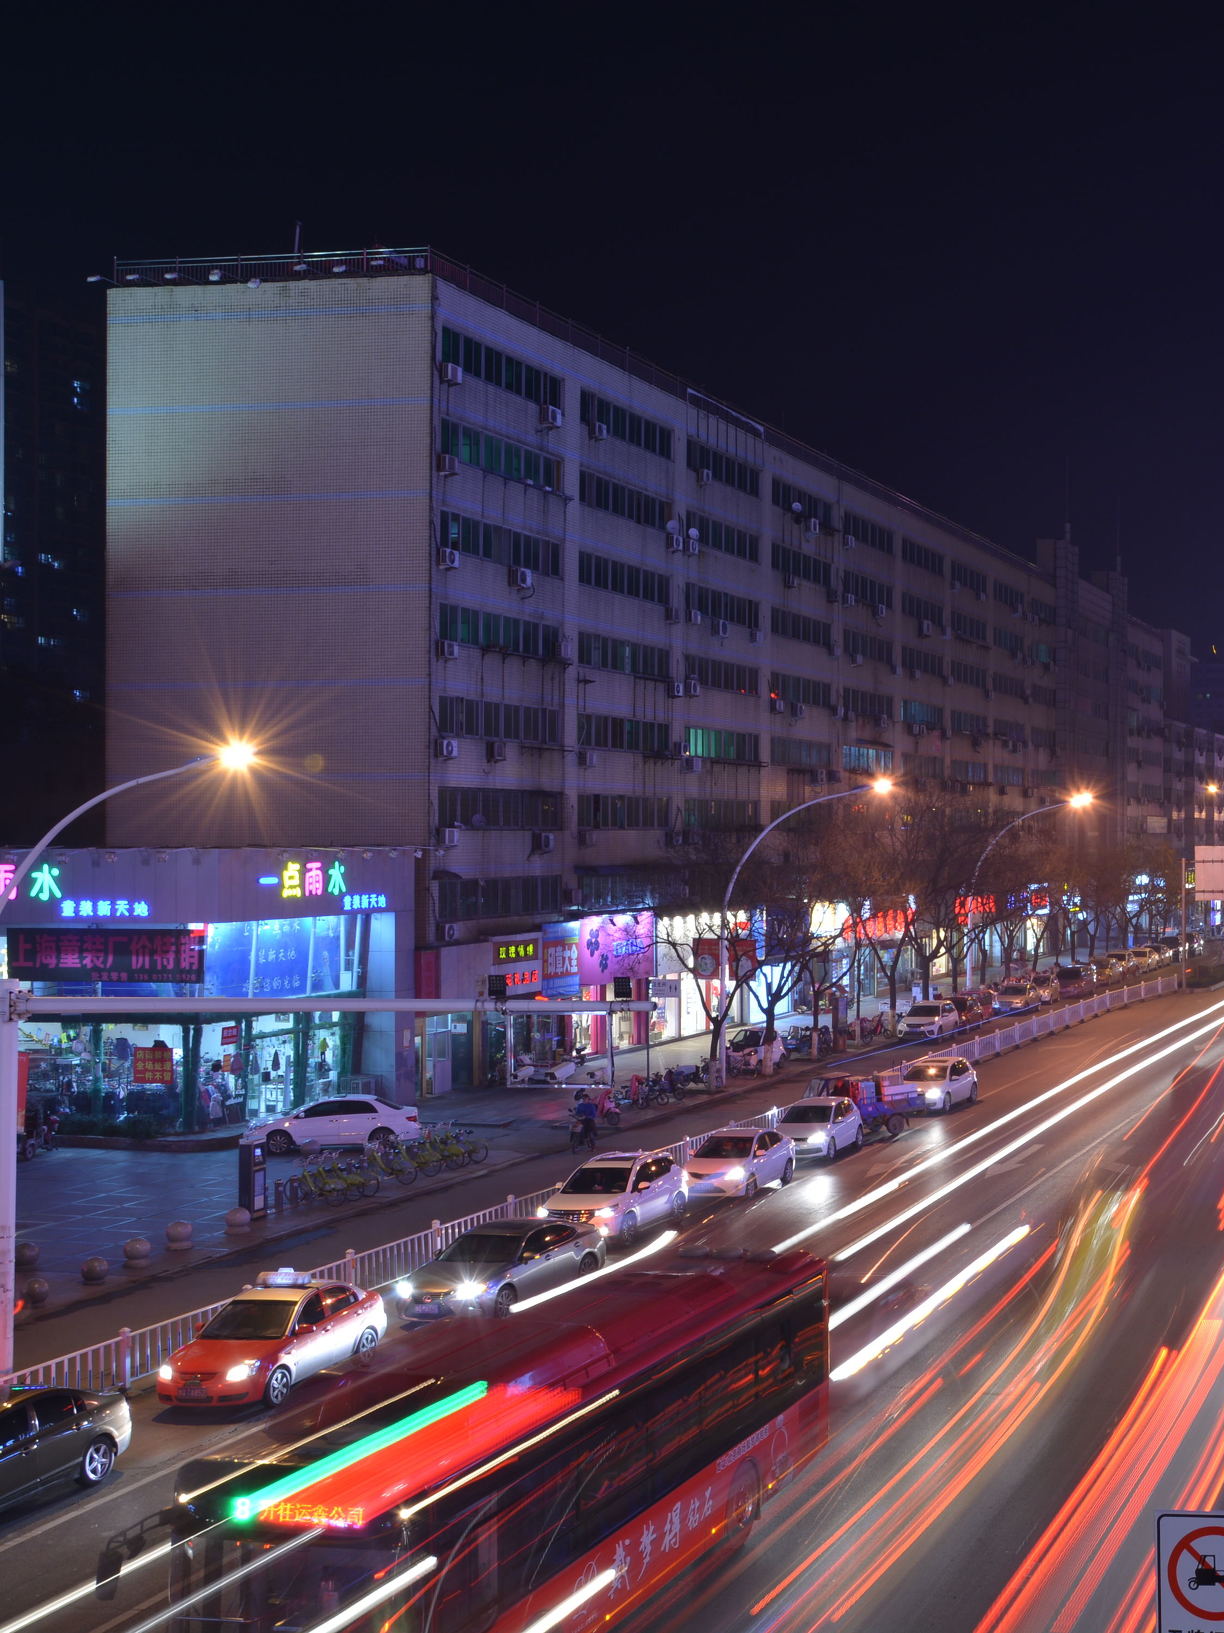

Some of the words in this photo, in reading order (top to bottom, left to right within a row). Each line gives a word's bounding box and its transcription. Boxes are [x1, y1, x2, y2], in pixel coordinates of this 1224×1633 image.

[258, 861, 347, 898] 一点雨水
[60, 900, 150, 917] 童装新天地
[343, 894, 387, 910] 童装新天地
